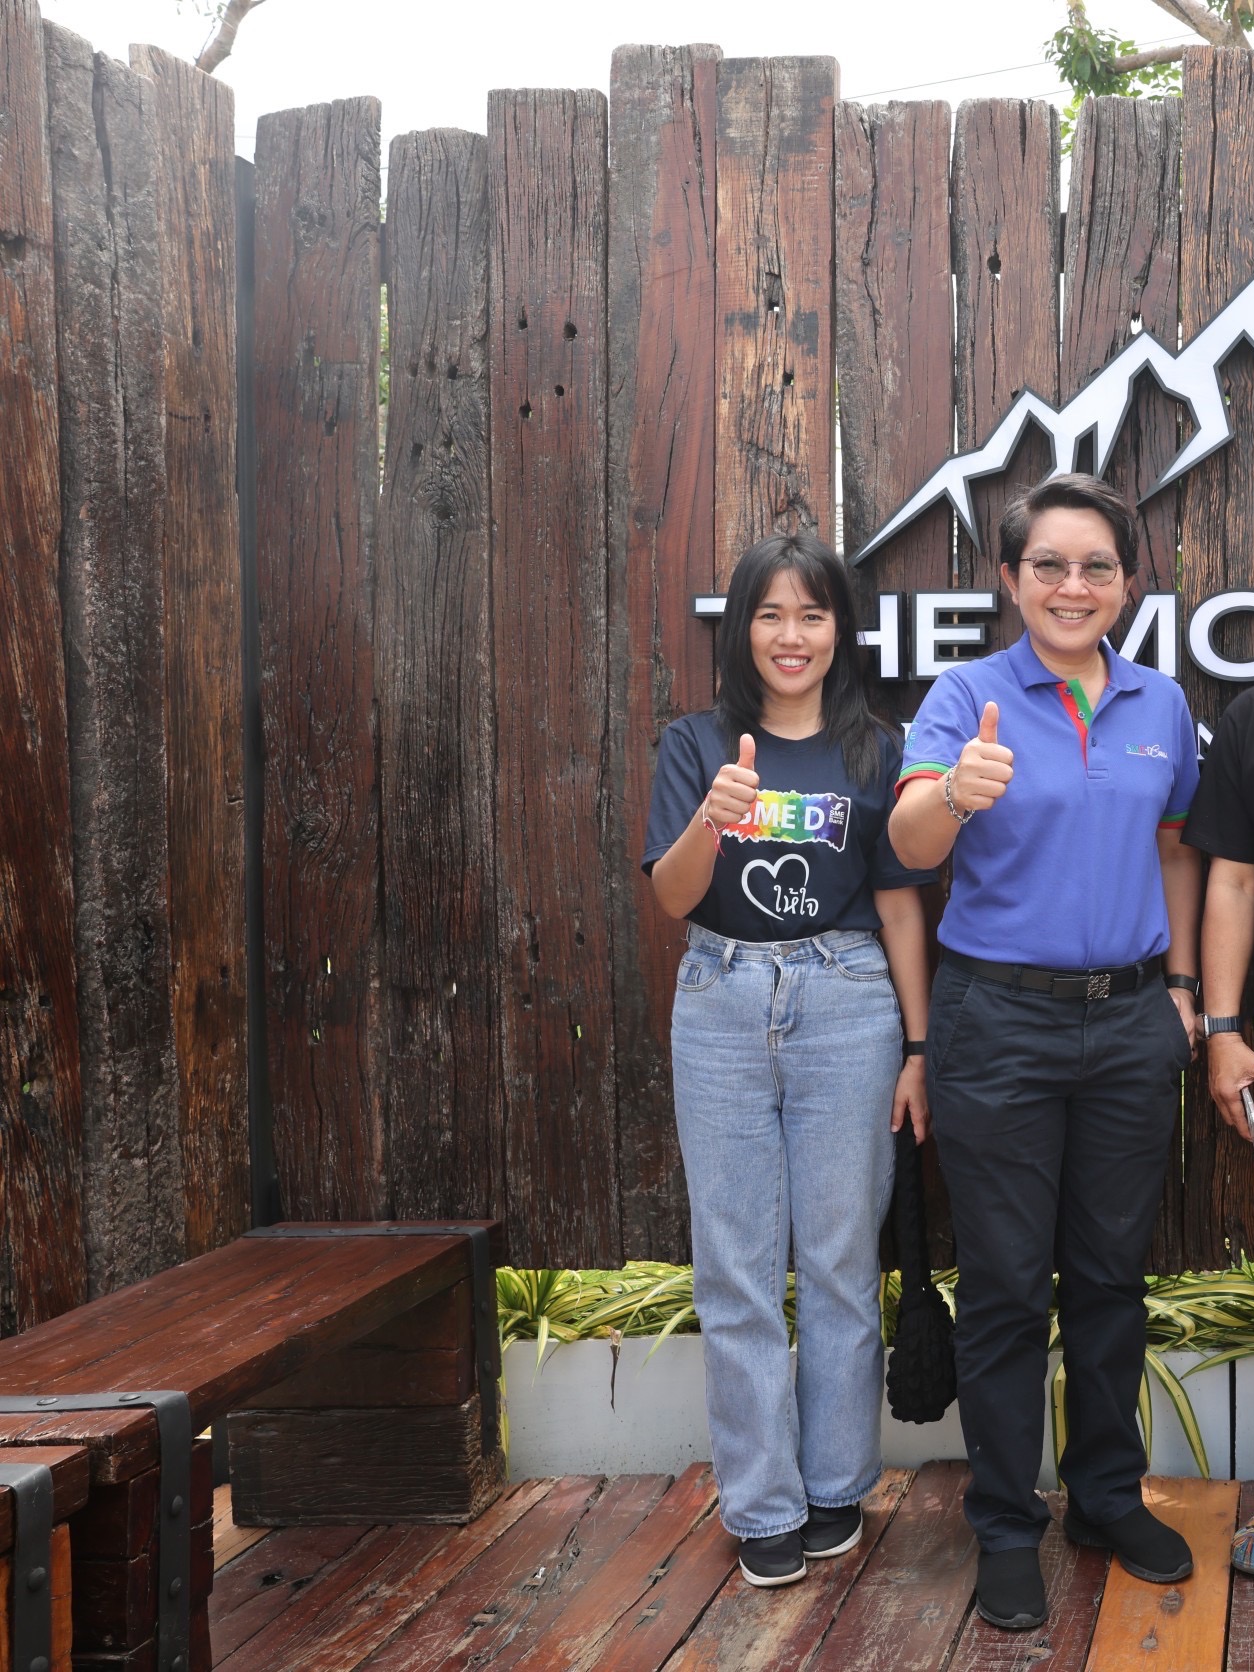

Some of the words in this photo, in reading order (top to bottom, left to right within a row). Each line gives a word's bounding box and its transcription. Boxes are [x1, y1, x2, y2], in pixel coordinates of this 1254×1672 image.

[693, 592, 994, 679] HE
[803, 806, 825, 831] D
[773, 884, 819, 917] ให้ใจ
